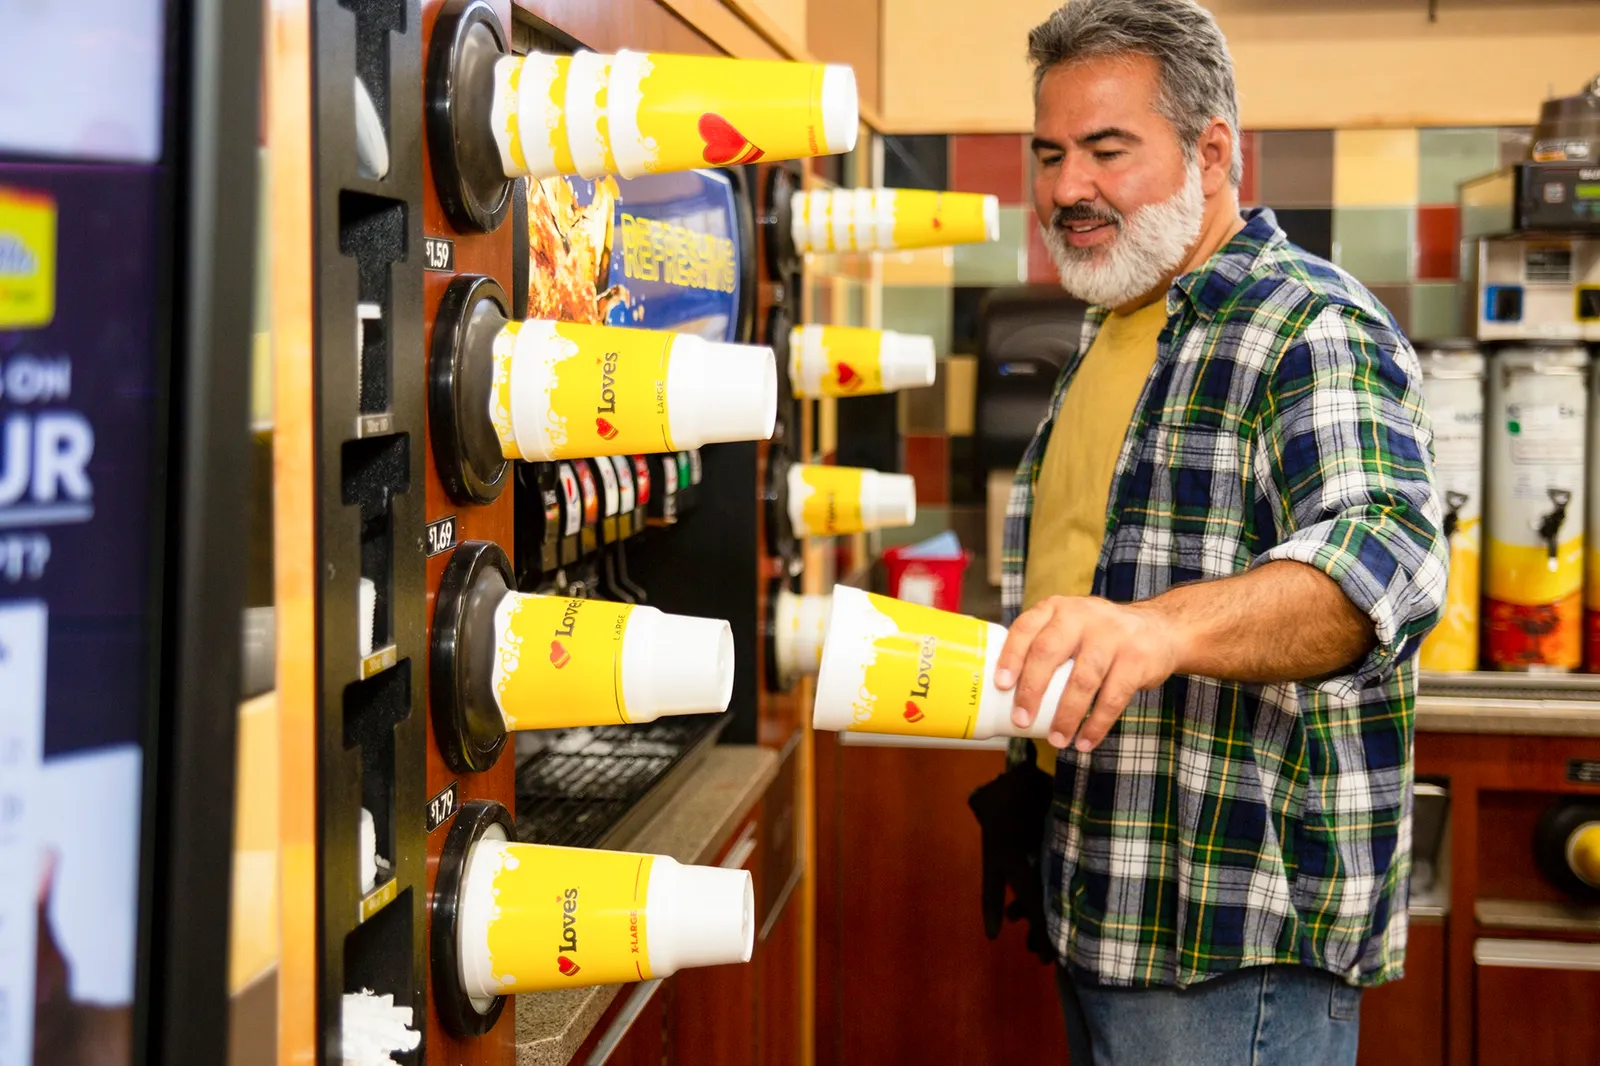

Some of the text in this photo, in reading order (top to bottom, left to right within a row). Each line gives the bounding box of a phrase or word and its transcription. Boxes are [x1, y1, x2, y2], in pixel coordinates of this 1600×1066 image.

[426, 240, 449, 268] $1.59
[656, 380, 664, 414] LARGE
[429, 521, 452, 552] $1.69
[613, 614, 625, 641] LARGE
[969, 673, 980, 706] LARGE
[431, 789, 453, 825] $1.79
[630, 909, 639, 954] X-LARGE
